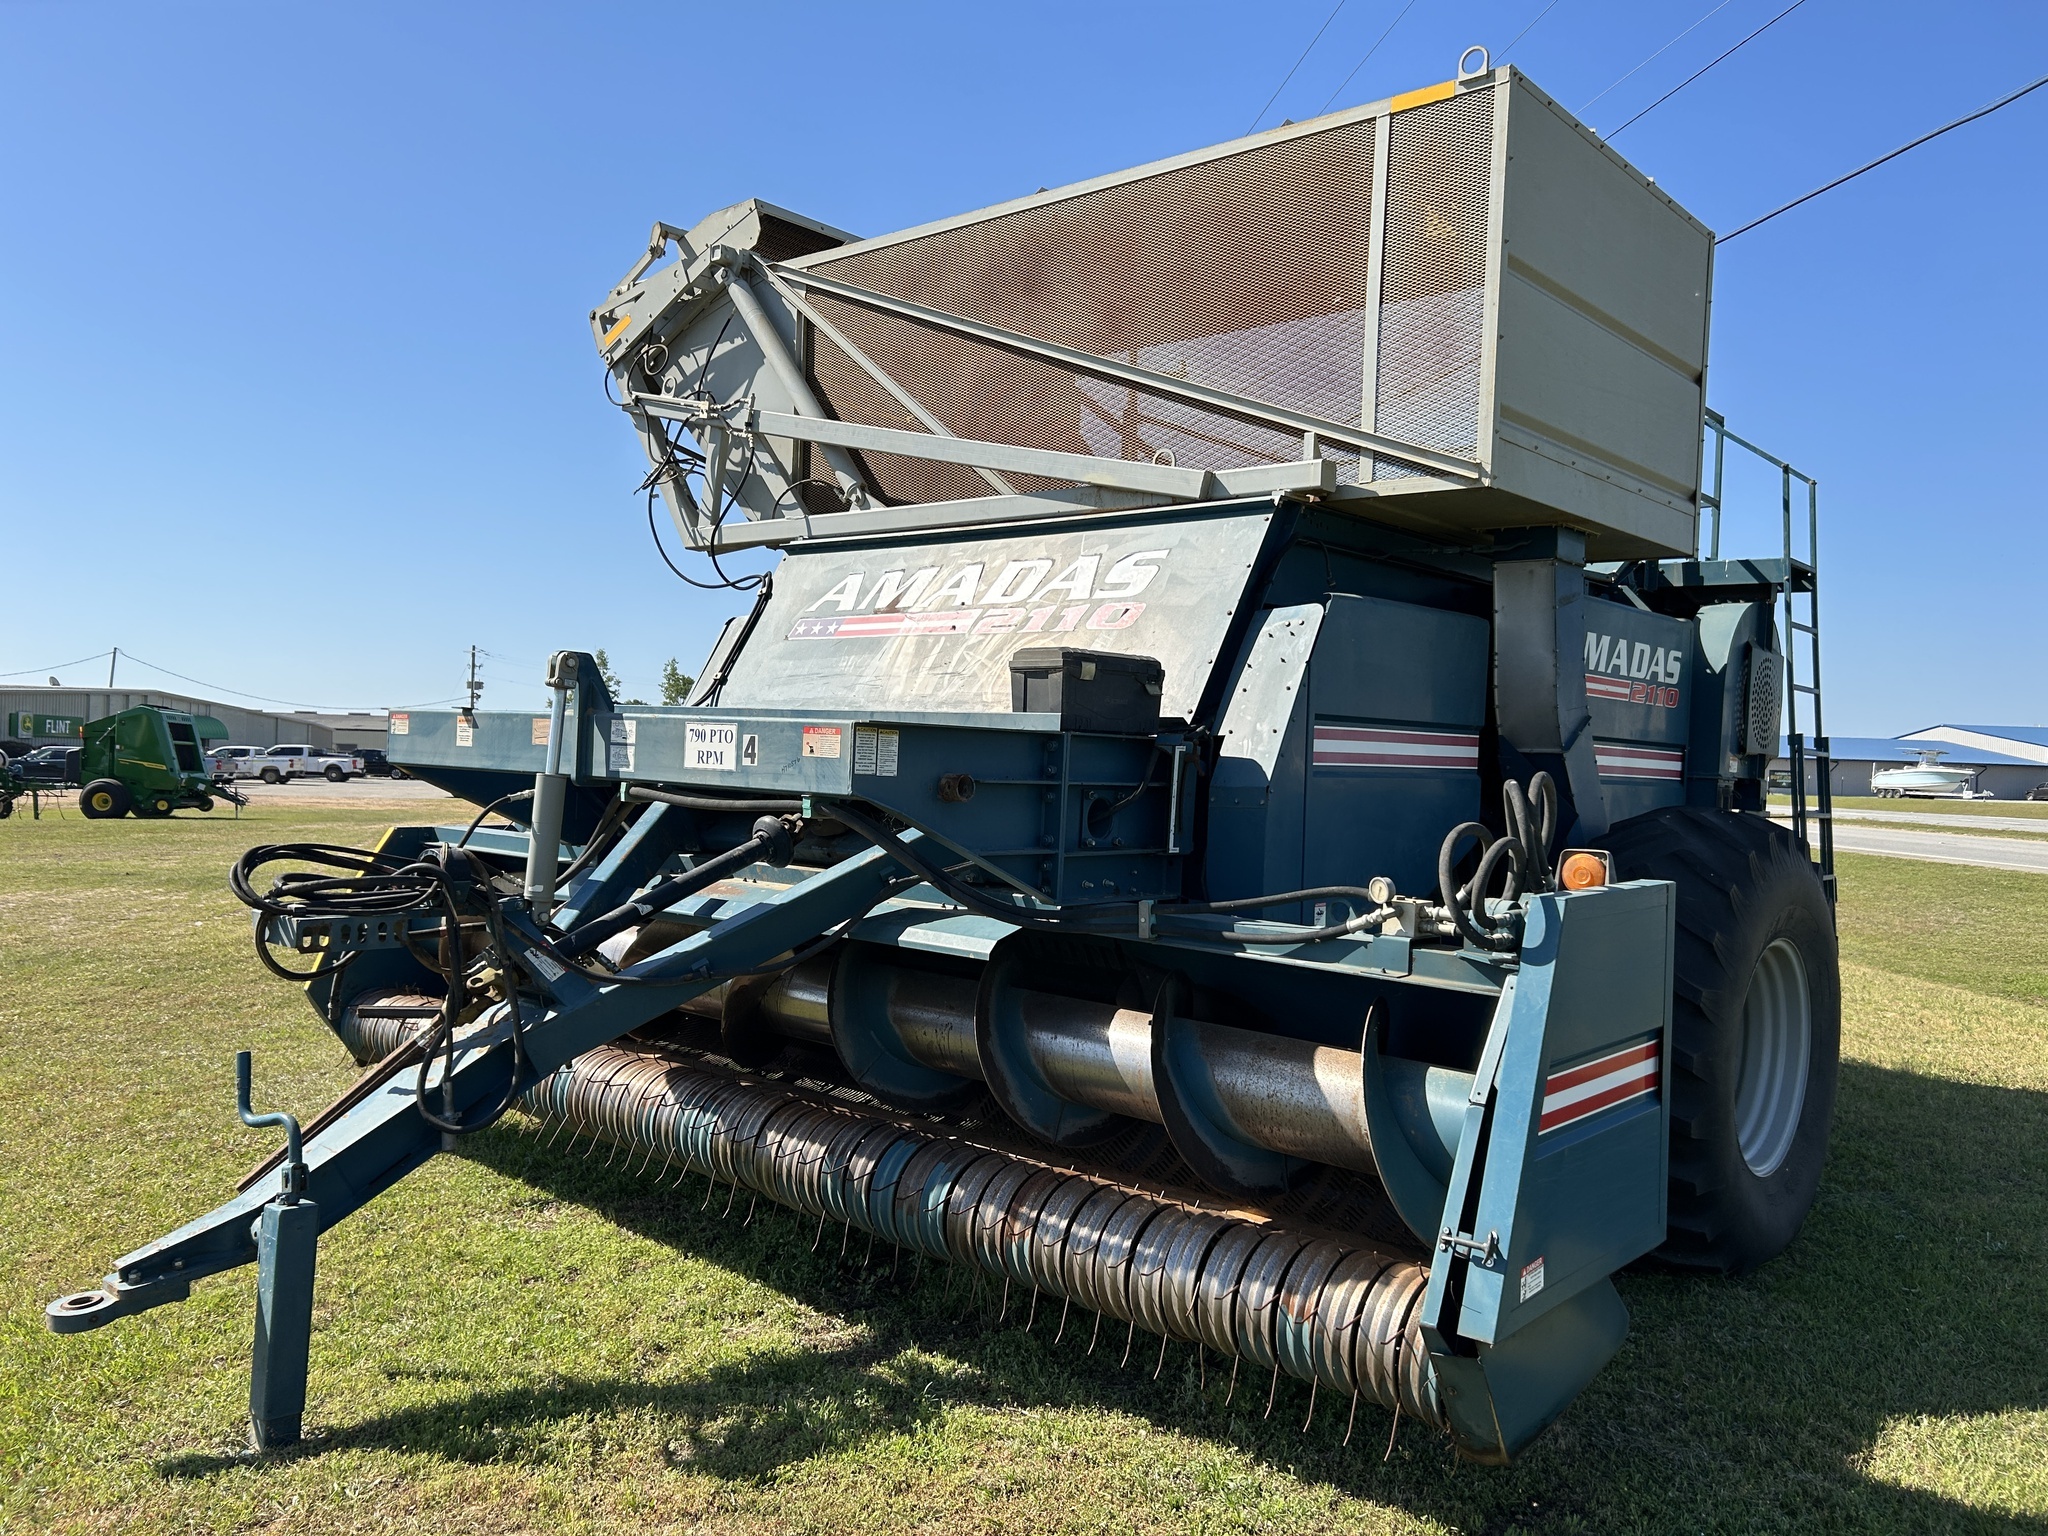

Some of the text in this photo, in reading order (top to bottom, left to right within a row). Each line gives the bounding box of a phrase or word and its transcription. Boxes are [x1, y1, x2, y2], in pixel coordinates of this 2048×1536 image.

[804, 548, 1171, 613] AMADAS
[971, 601, 1147, 635] 2110
[1584, 631, 1682, 685] MADAS
[1630, 681, 1679, 708] 2110
[46, 719, 71, 734] FLINT
[689, 728, 734, 744] 790 PTO
[697, 750, 724, 765] RPM
[744, 735, 757, 765] 4
